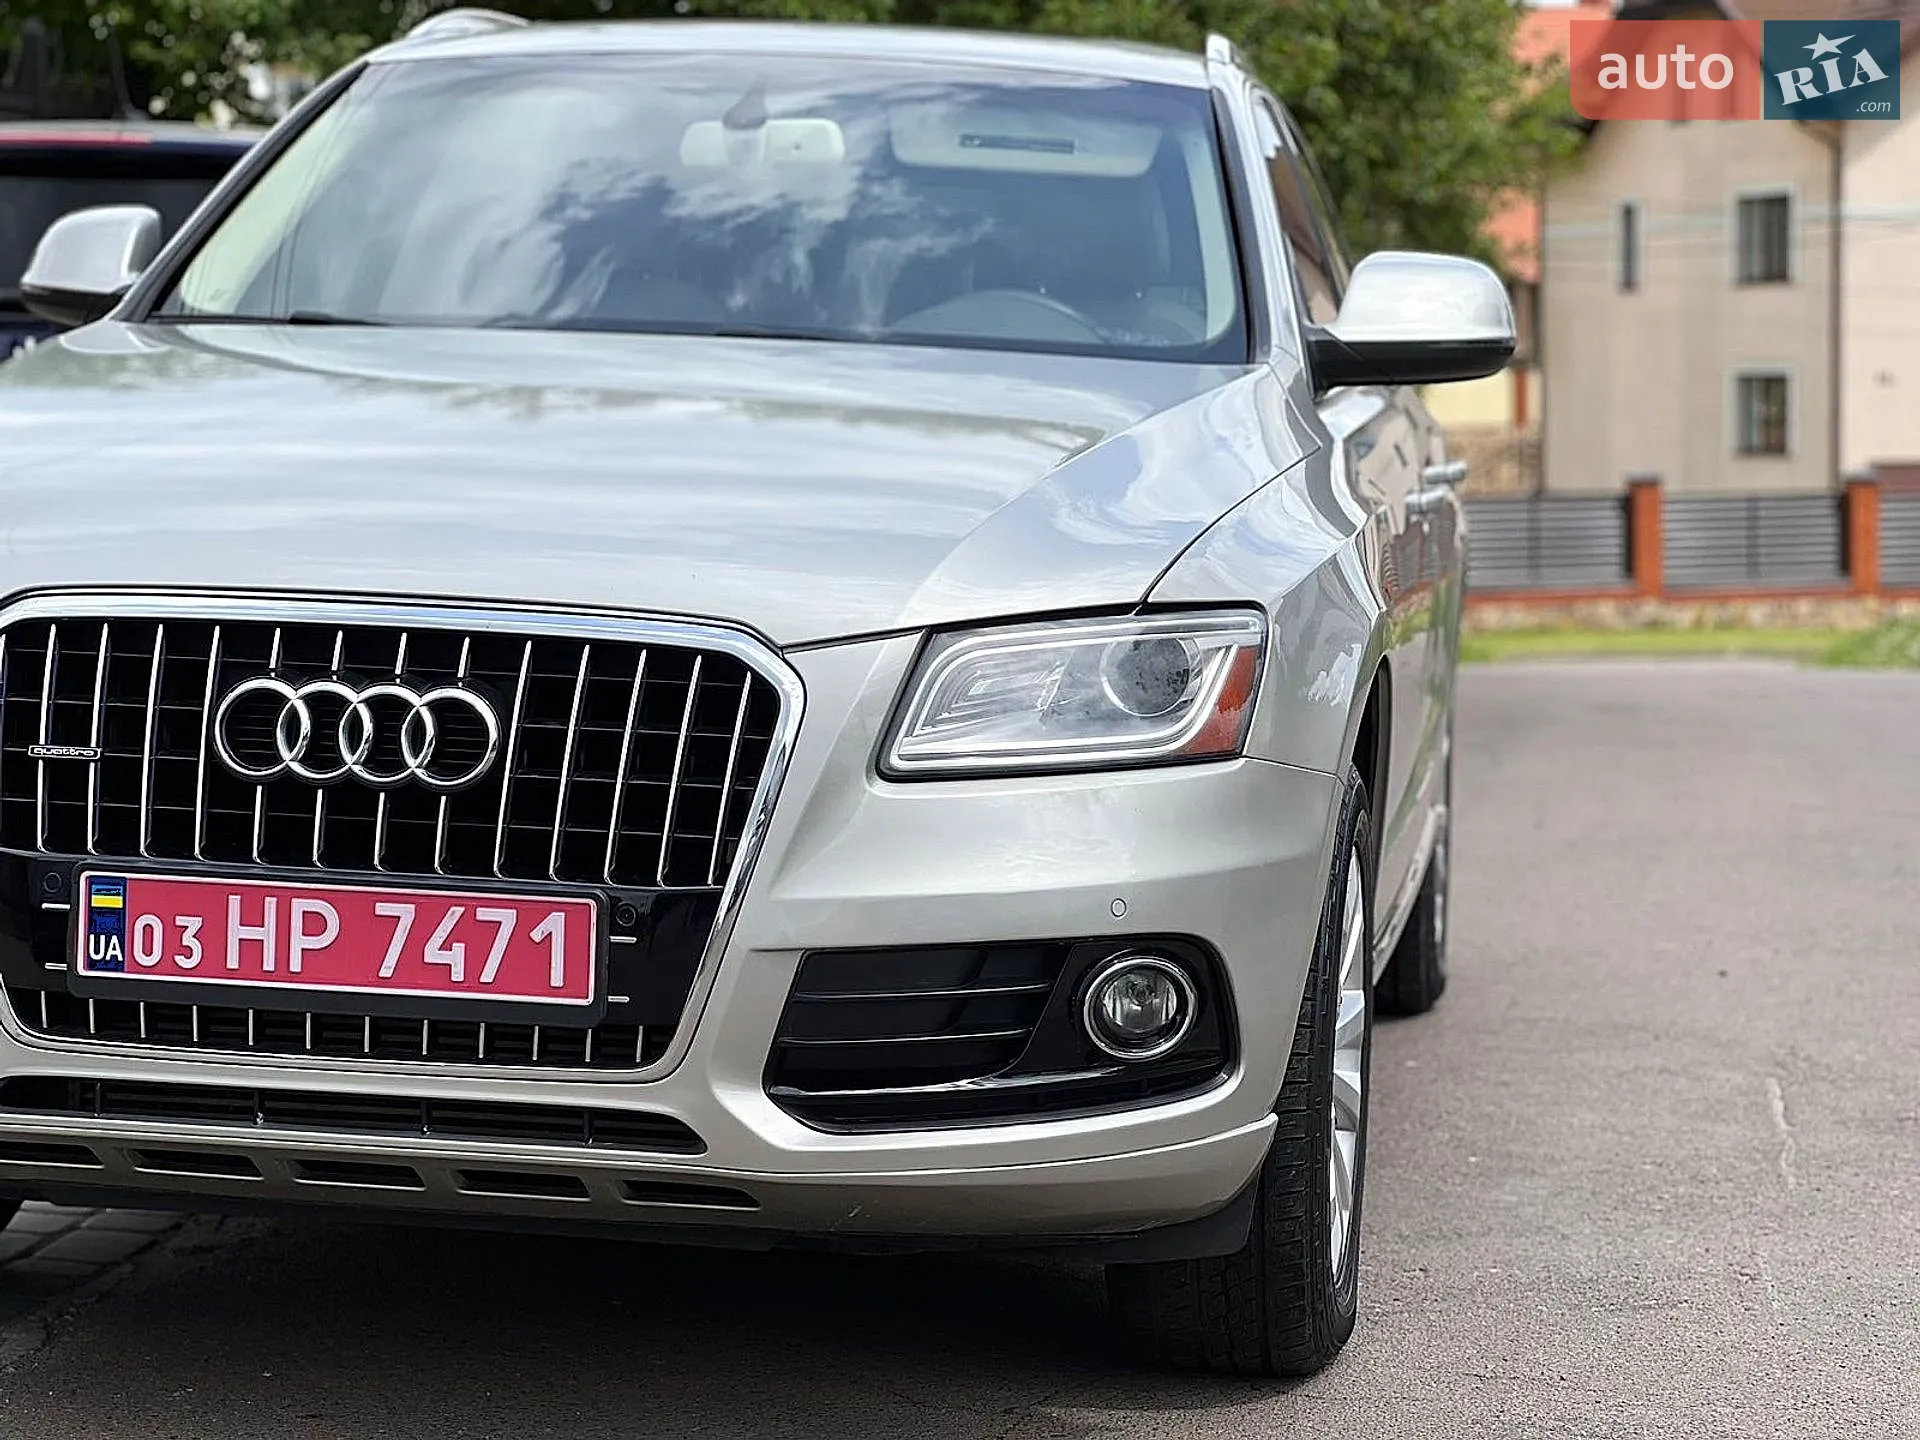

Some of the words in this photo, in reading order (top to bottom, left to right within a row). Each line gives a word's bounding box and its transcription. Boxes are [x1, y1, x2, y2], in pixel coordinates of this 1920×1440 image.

[33, 747, 95, 757] quattro
[88, 934, 124, 963] UA
[132, 914, 204, 970] 03
[225, 894, 342, 973] HP
[374, 901, 567, 989] 7471
